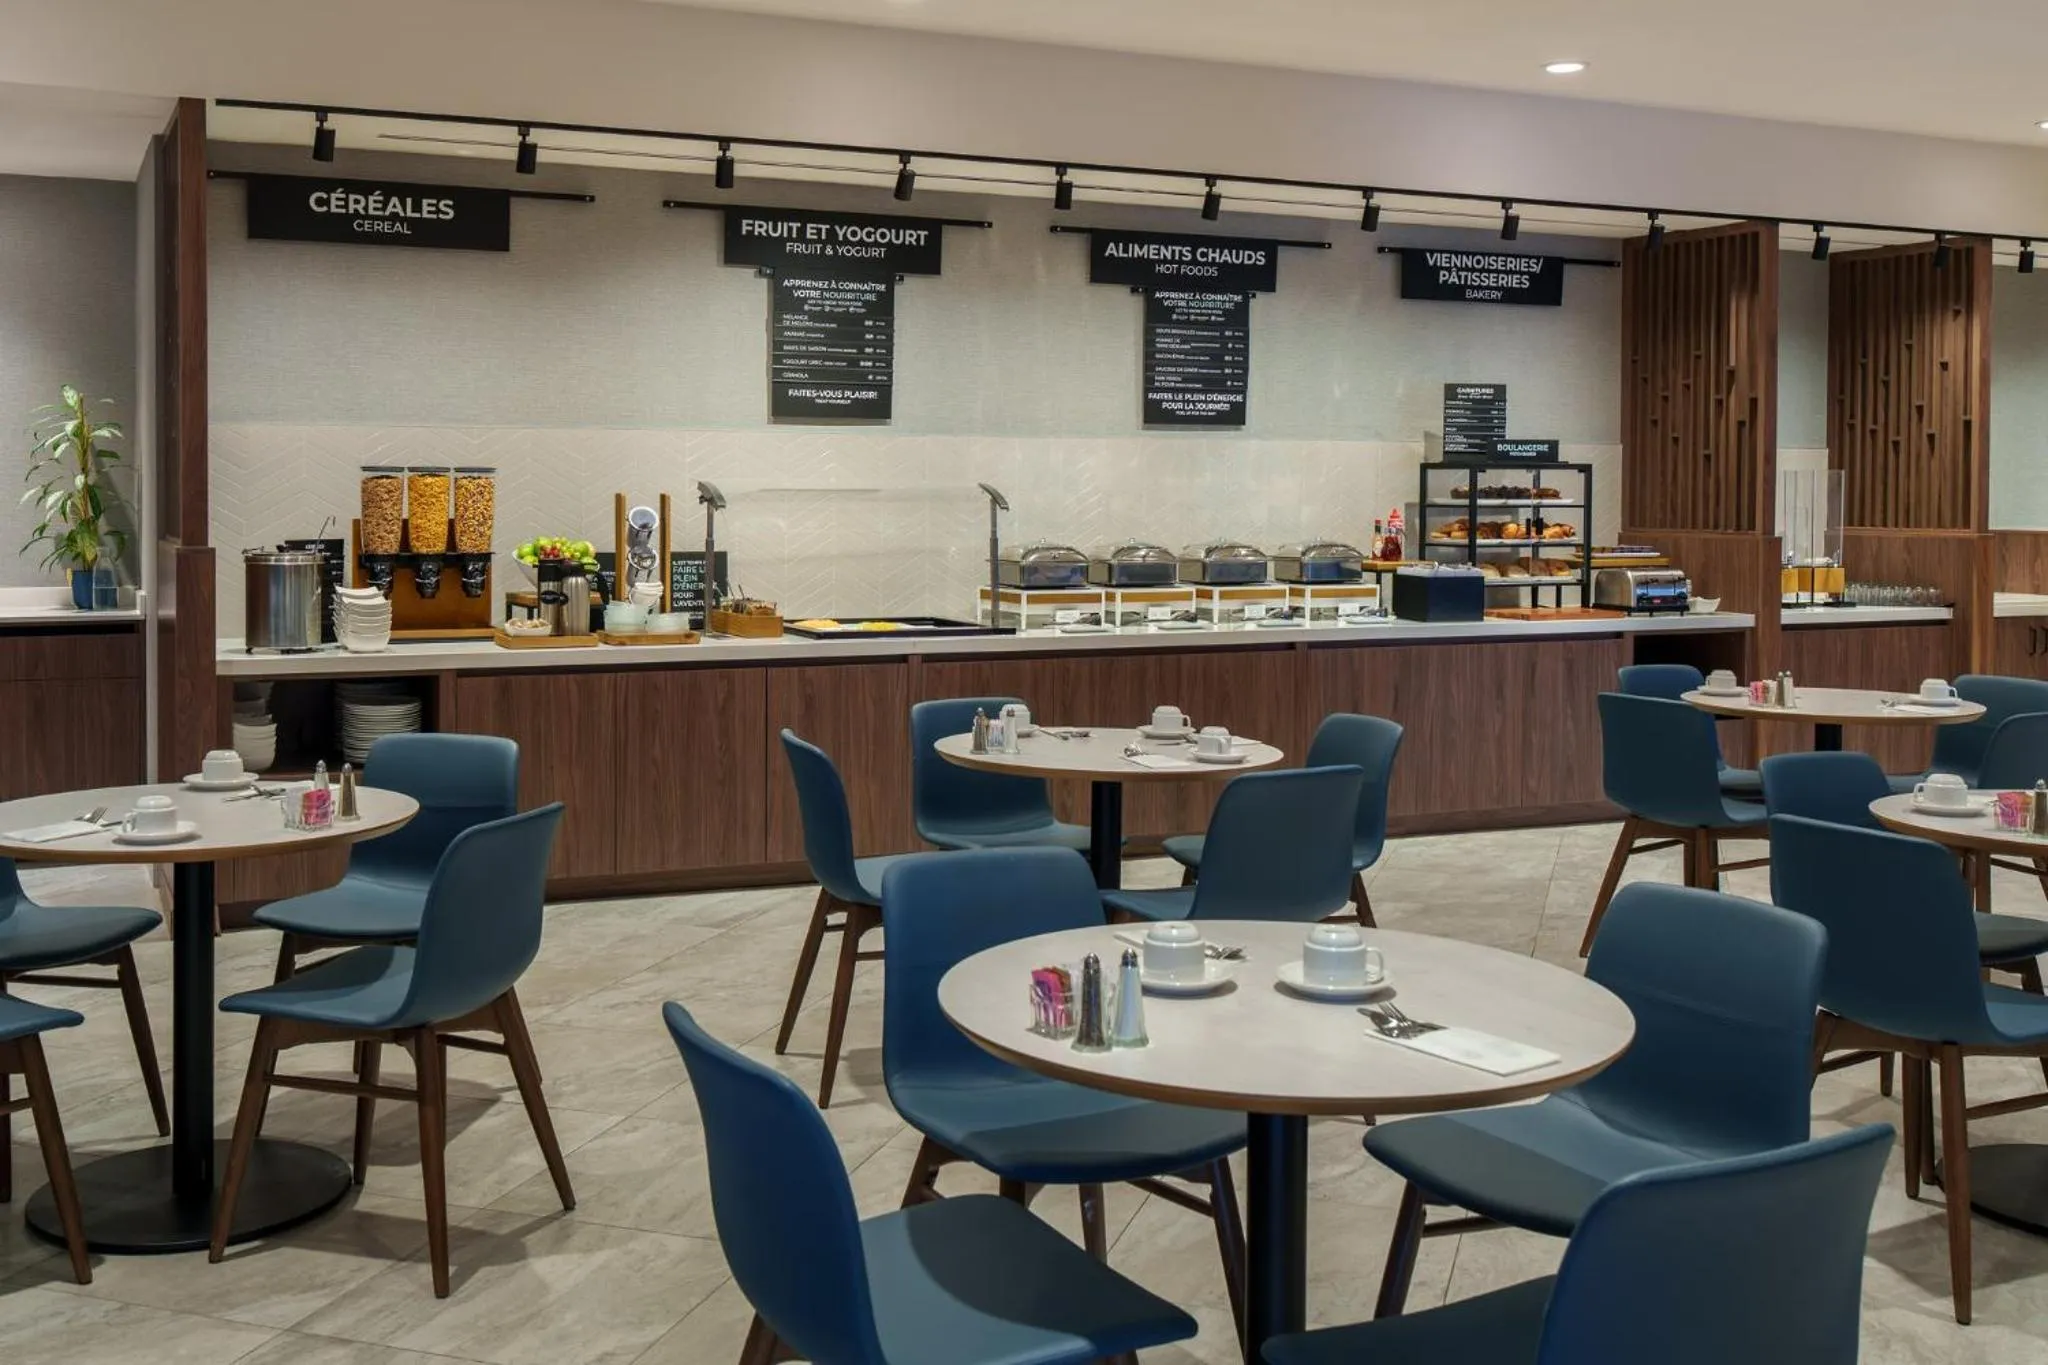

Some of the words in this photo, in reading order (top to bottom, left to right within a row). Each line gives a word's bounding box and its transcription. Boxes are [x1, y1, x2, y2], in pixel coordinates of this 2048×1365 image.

[309, 188, 455, 220] CÉRÉALES
[353, 219, 412, 234] CEREAL
[741, 219, 801, 238] FRUIT
[806, 223, 830, 240] ET
[834, 225, 929, 246] YOGOURT
[786, 242, 823, 255] FRUIT
[825, 244, 834, 256] &
[836, 245, 887, 258] YOGURT
[1105, 242, 1193, 261] ALIMENTS
[1196, 248, 1266, 266] CHAUDS
[1426, 252, 1544, 274] VIENNOISERIES/
[1155, 264, 1179, 274] HOT
[1180, 265, 1219, 276] FOODS
[1439, 268, 1530, 288] PÂTISSERIES
[783, 279, 829, 289] APPRENEZ
[838, 281, 887, 292] CONNAÎTRE
[792, 289, 821, 298] VOTRE
[823, 291, 877, 301] NOURRITURE
[1154, 291, 1194, 300] APPRENEZ
[1465, 289, 1503, 300] BAKERY
[1497, 443, 1549, 452] BOULANGERIE
[673, 565, 698, 574] FAIRE
[673, 574, 698, 582] PLEIN
[673, 582, 706, 591] D'ÉNER
[673, 591, 695, 599] POUR
